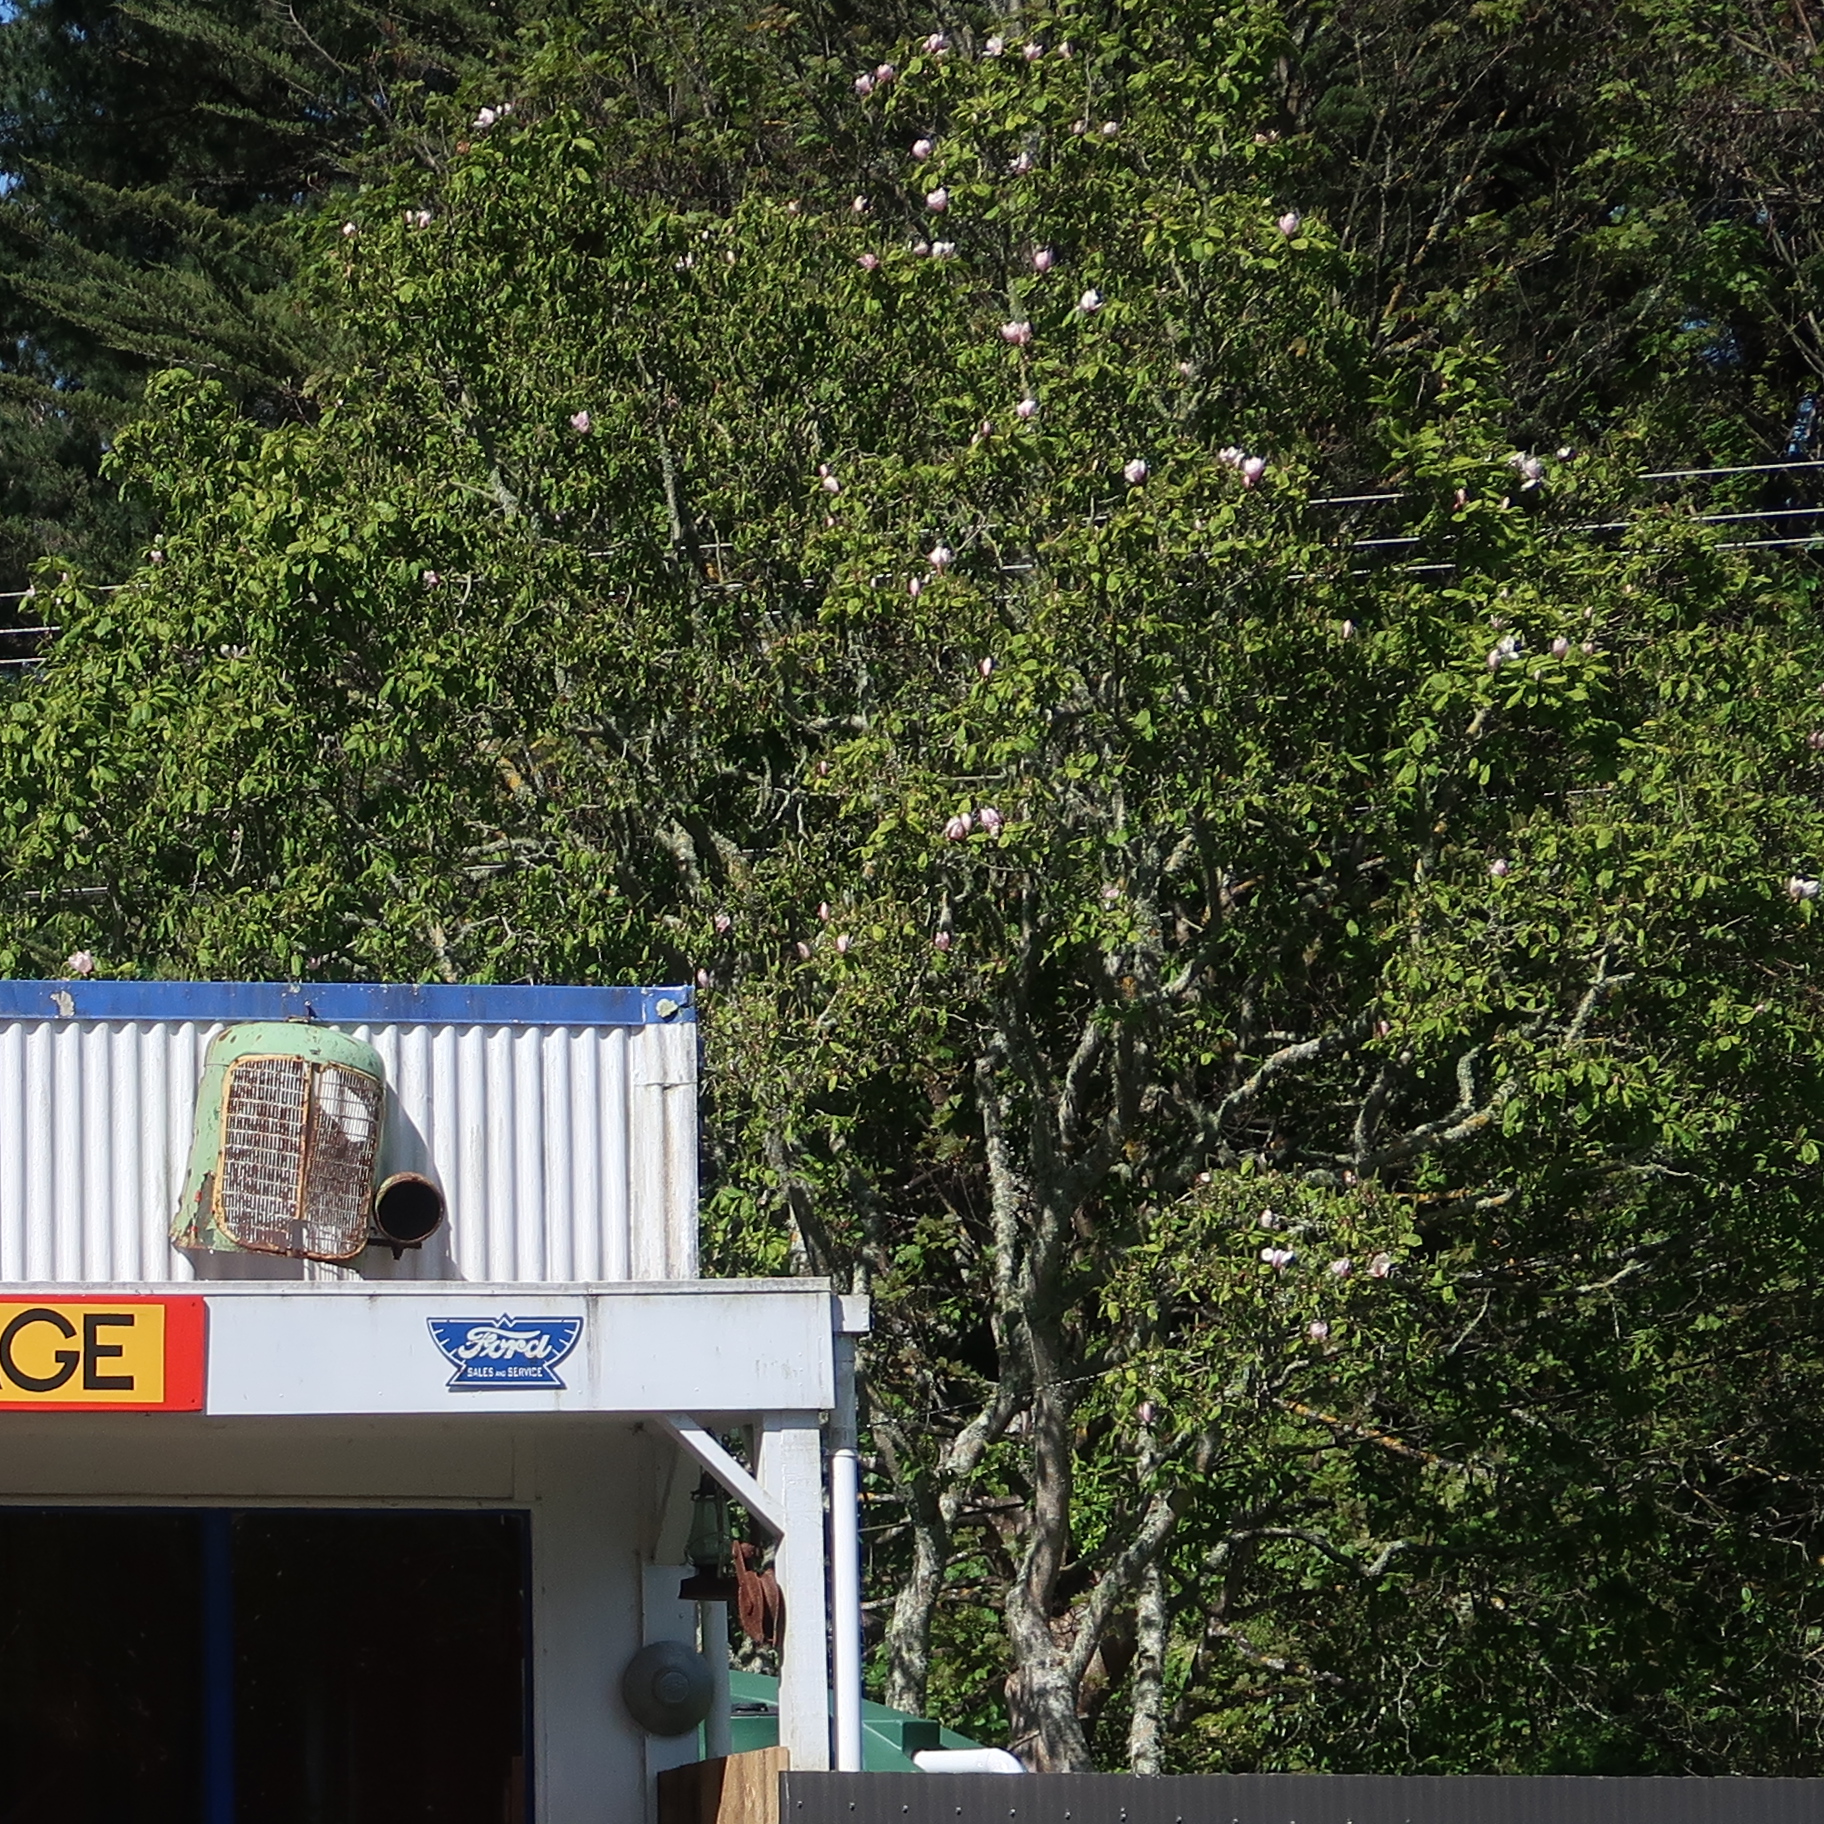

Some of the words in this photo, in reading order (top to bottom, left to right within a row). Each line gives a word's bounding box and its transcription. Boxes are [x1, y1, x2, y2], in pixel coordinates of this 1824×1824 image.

[457, 1326, 552, 1360] Ford
[467, 1366, 494, 1378] SALES
[507, 1366, 543, 1377] SERVICE
